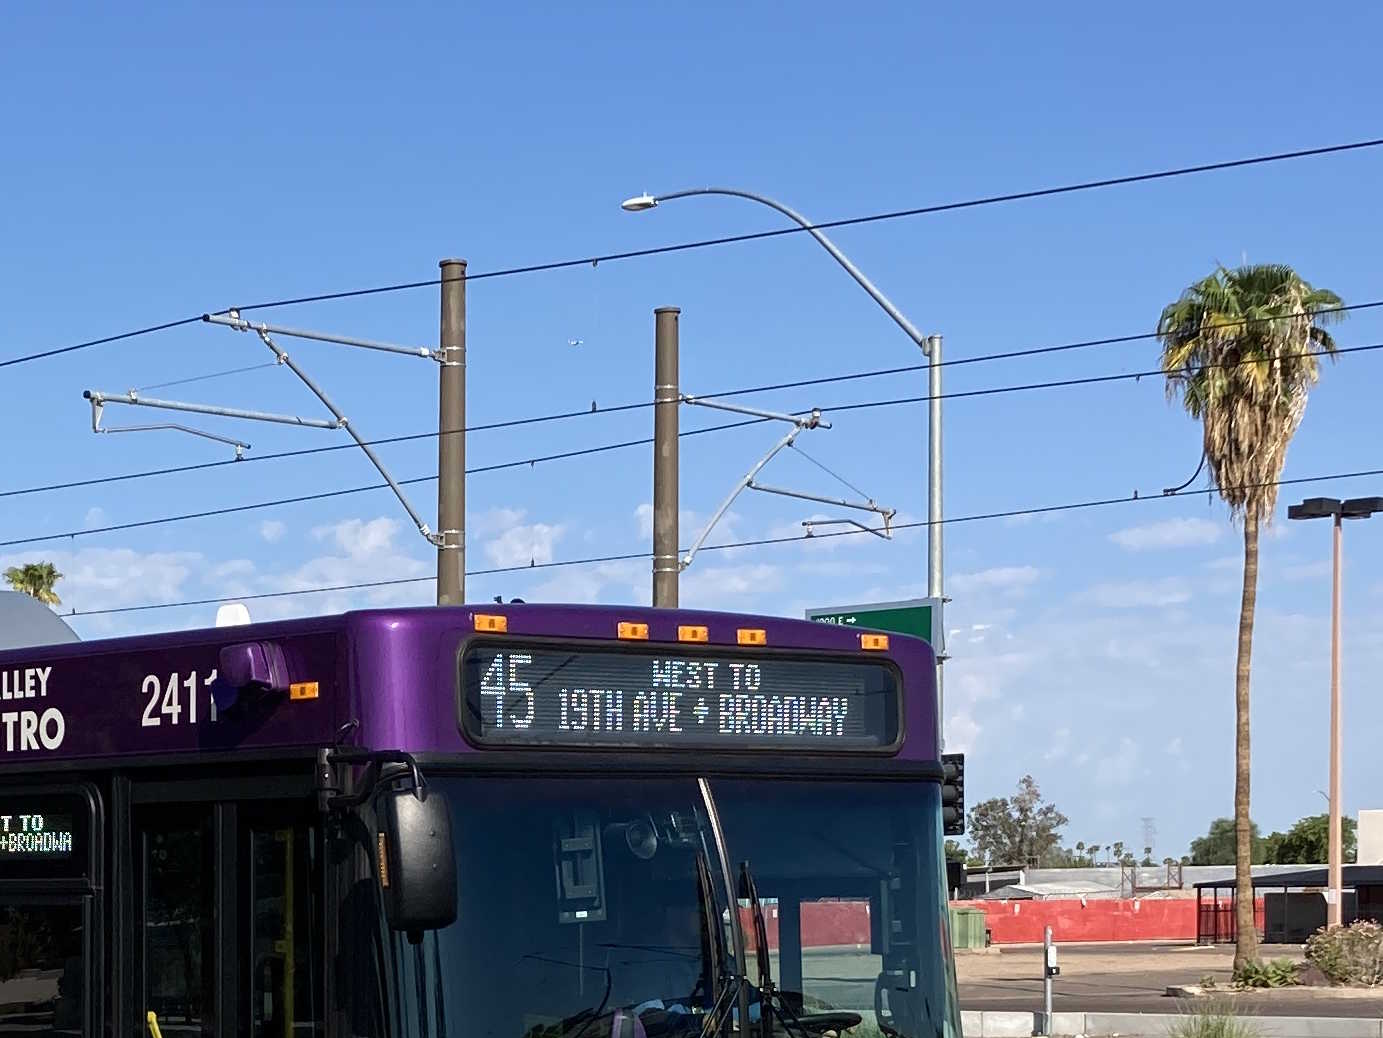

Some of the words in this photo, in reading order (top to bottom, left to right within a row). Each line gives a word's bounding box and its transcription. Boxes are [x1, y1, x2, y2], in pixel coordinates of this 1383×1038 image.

[141, 669, 218, 727] 2411
[480, 653, 535, 729] 45
[652, 660, 719, 688] WEST
[729, 663, 762, 690] TO
[558, 687, 624, 732] 19TH
[633, 691, 684, 733] AVE
[719, 693, 849, 737] BROADWAY
[19, 814, 45, 832] TO
